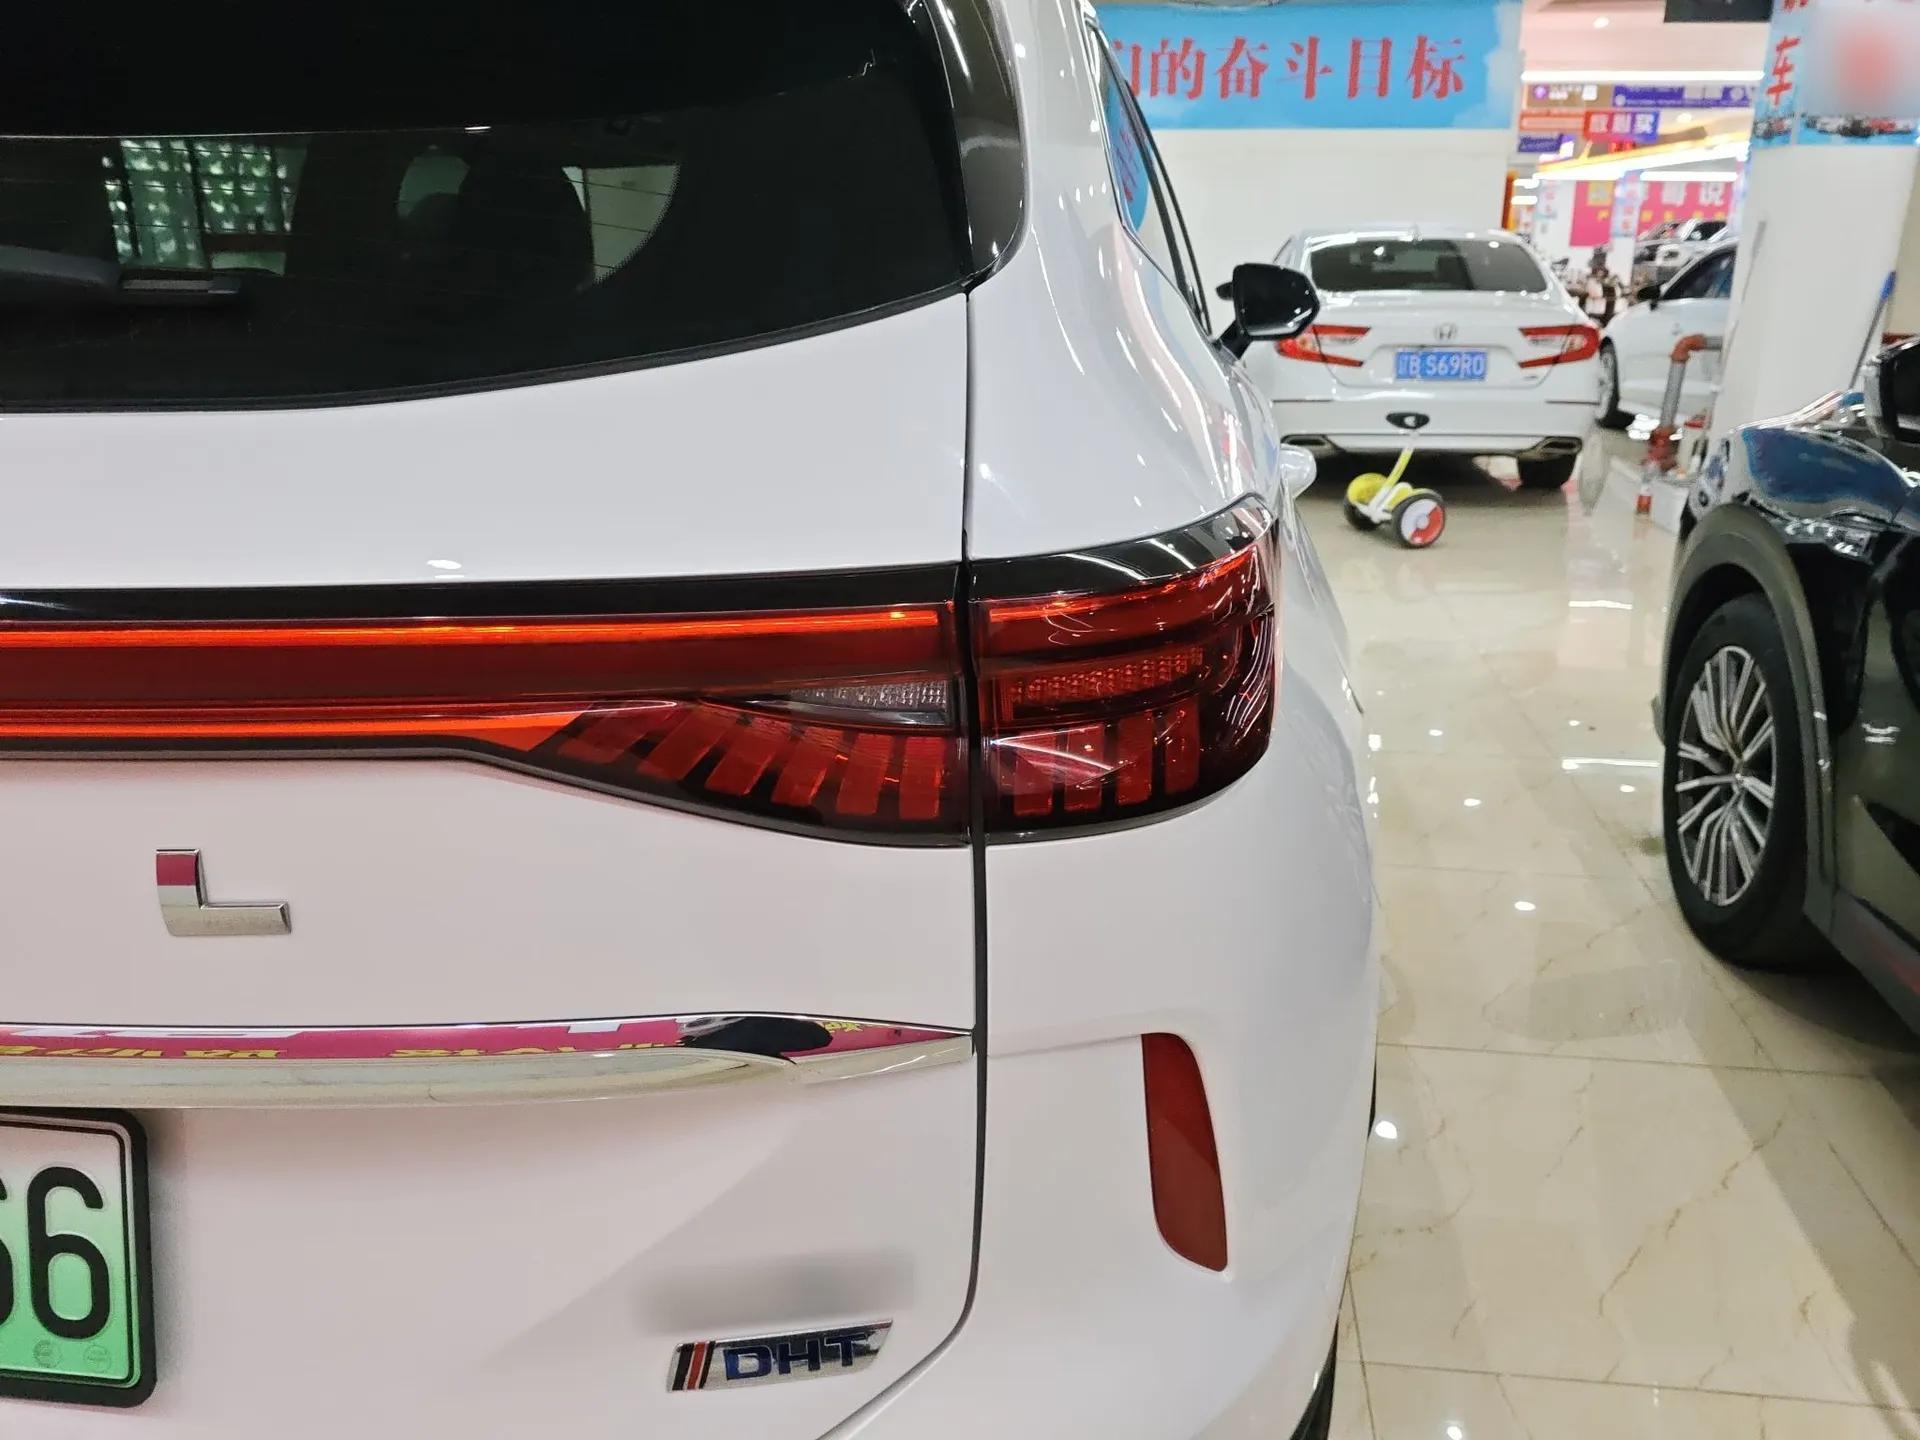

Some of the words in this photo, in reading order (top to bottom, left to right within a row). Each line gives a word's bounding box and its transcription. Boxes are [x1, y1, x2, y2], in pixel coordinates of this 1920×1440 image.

[156, 849, 292, 937] L
[0, 1166, 111, 1341] 6
[723, 1330, 871, 1381] DHT
